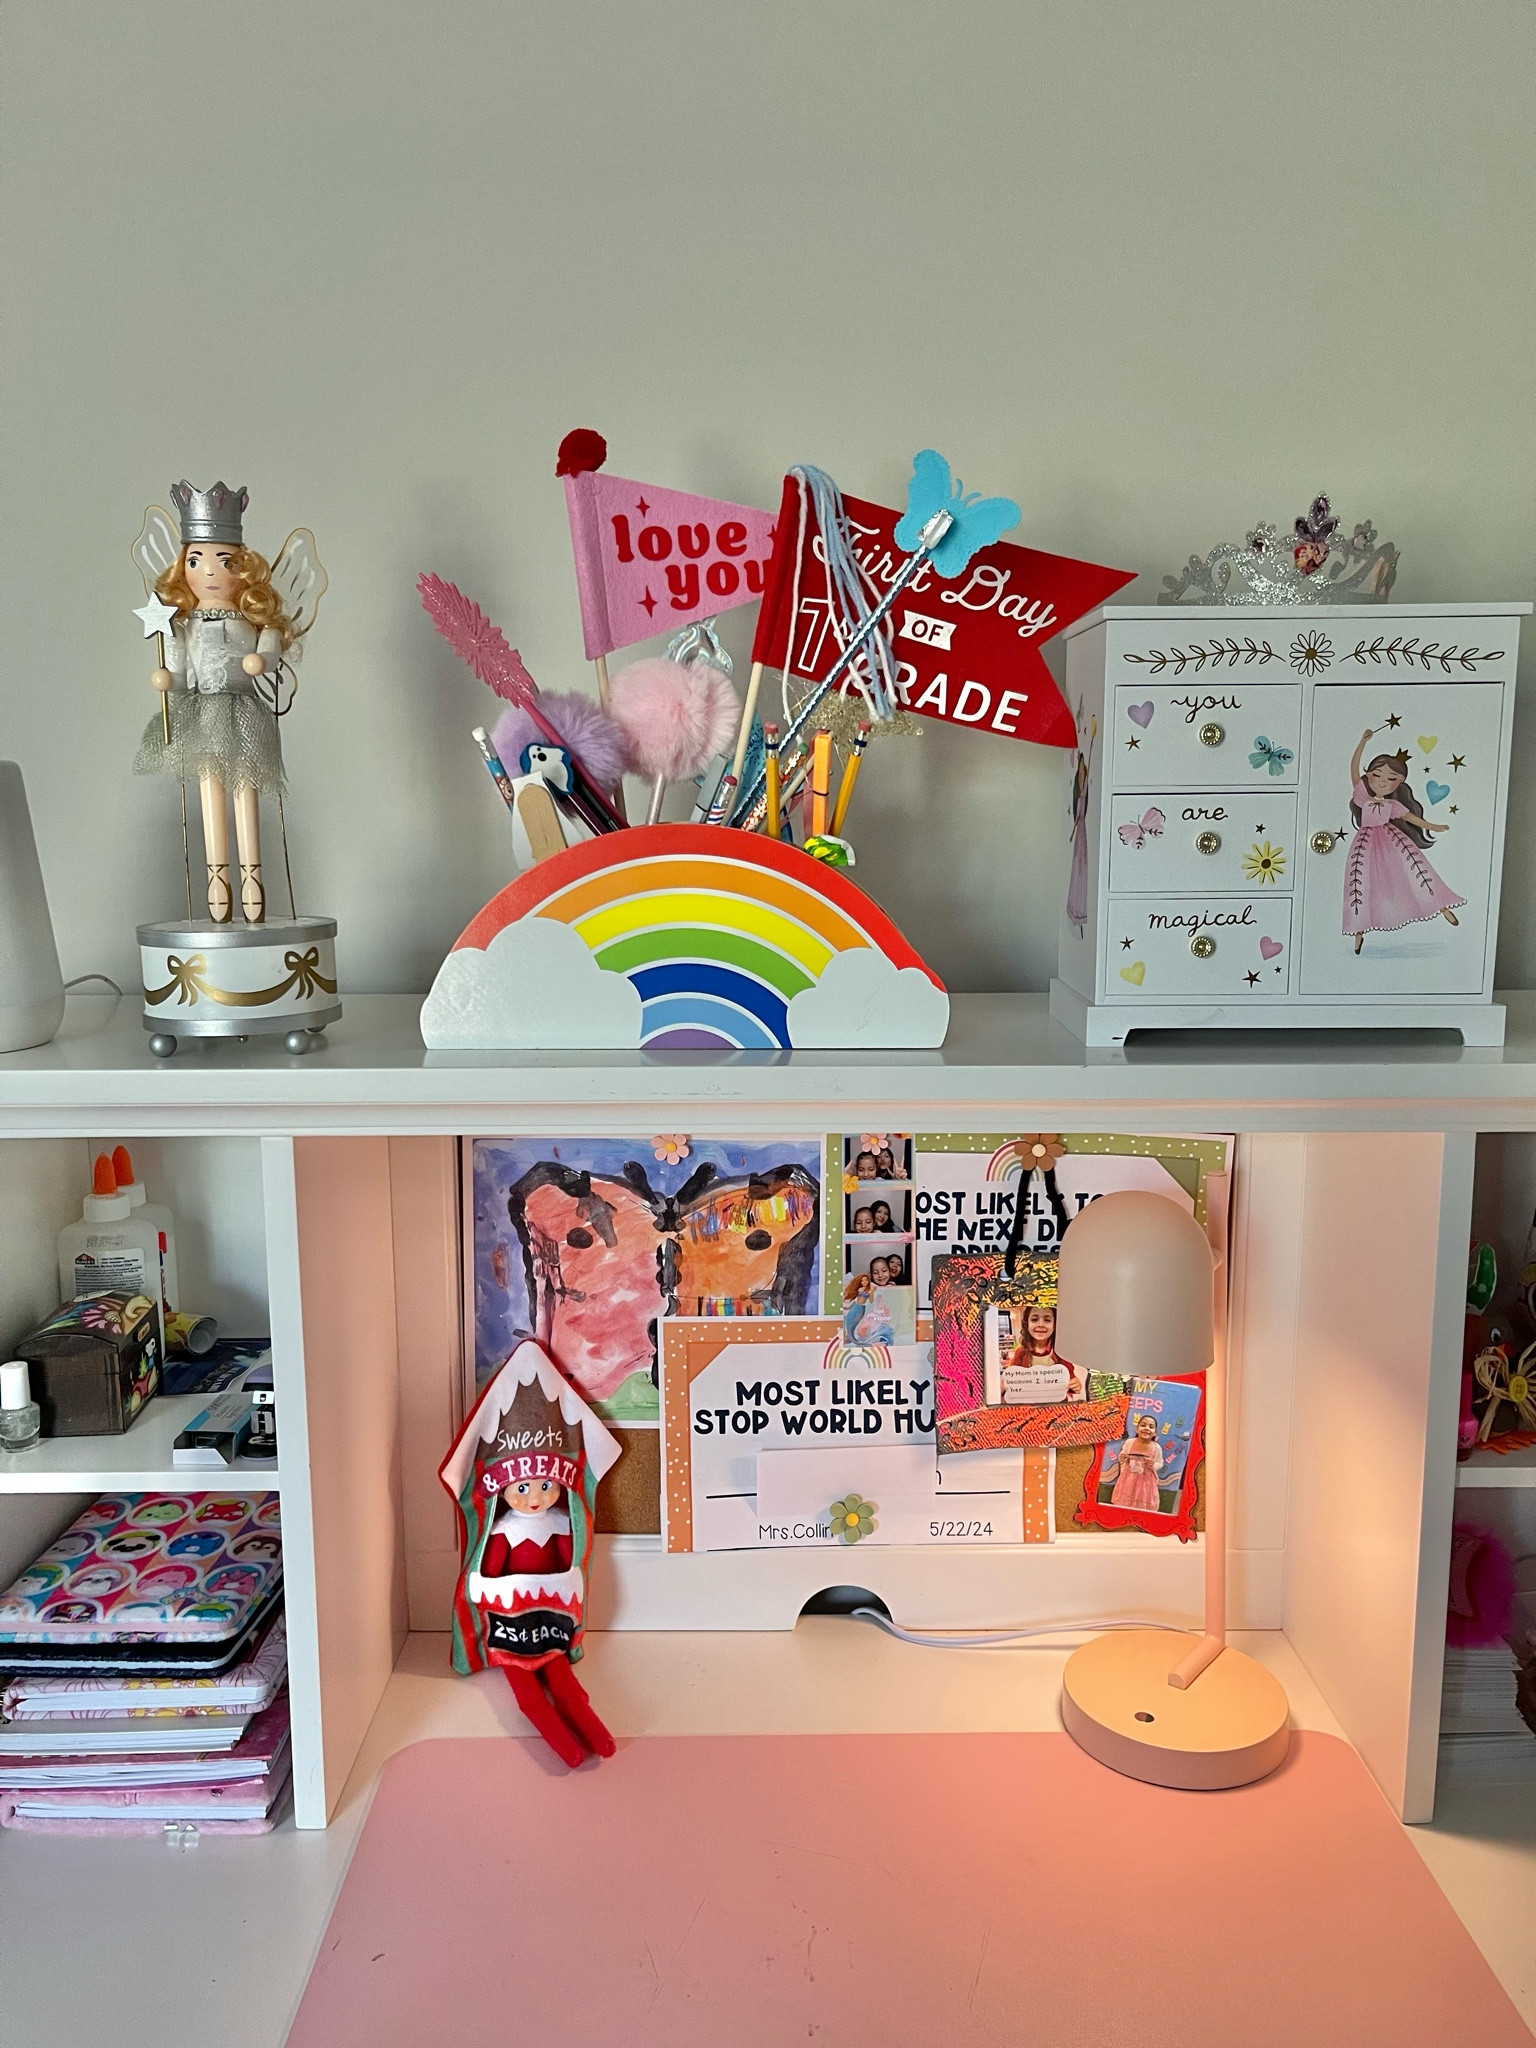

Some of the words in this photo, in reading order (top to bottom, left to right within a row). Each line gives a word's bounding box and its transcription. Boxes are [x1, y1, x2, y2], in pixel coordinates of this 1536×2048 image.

[611, 514, 747, 563] love
[665, 558, 771, 611] you
[940, 564, 1057, 637] Day
[911, 619, 944, 642] OF
[1171, 694, 1241, 723] you
[1181, 804, 1228, 821] are
[1148, 905, 1258, 936] magical
[915, 1190, 967, 1216] OST
[915, 1217, 948, 1242] HE
[736, 1380, 821, 1406] MOST
[832, 1379, 930, 1406] LIKELY
[1134, 1381, 1159, 1395] MY
[693, 1408, 770, 1435] STOP
[780, 1408, 883, 1435] WORLD
[482, 1473, 500, 1492] &
[501, 1455, 578, 1486] TREATS
[929, 1520, 993, 1537] 5/22/24
